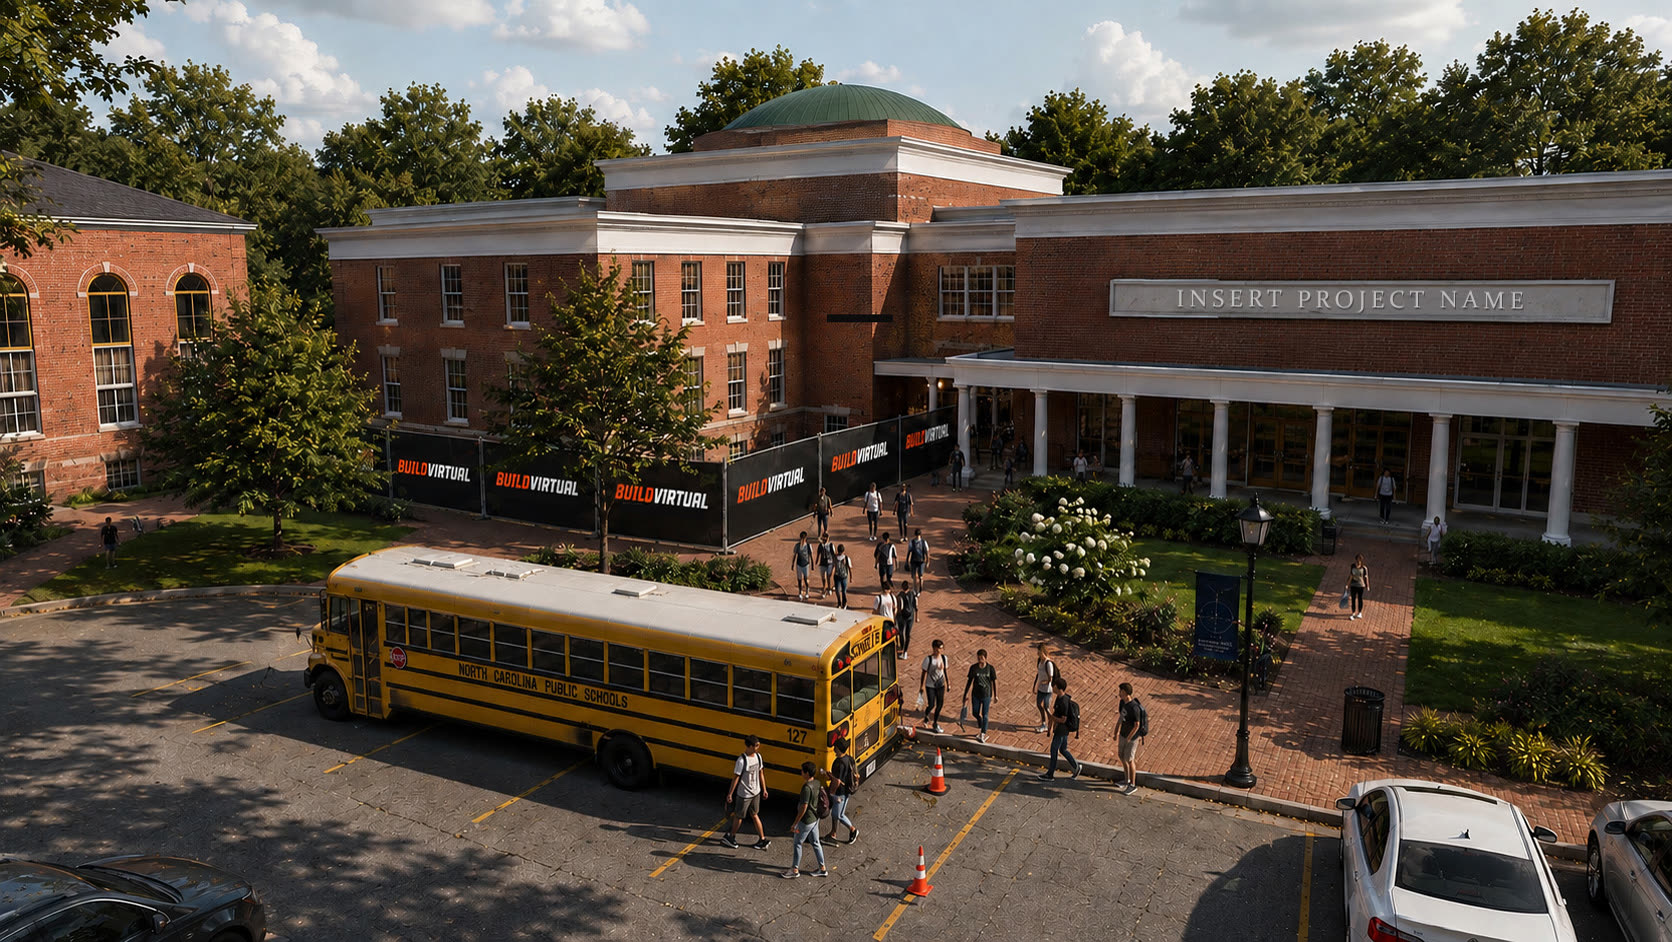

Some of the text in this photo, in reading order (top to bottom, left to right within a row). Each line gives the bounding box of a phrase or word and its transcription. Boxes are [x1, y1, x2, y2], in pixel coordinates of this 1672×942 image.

[1177, 289, 1525, 313] INSERT PROJECT NAME
[831, 441, 889, 473] BUILDVIRTUAL
[397, 458, 471, 483] BUILDVIRTUAL
[495, 471, 579, 497] BUILDVIRTUAL
[614, 483, 709, 510] BUILDVIRTUAL
[736, 466, 805, 504] BUILDVIRTUAL
[458, 662, 628, 708] NORTH CAROLINA PUBLIC SCHOOLS
[786, 727, 808, 745] 127
